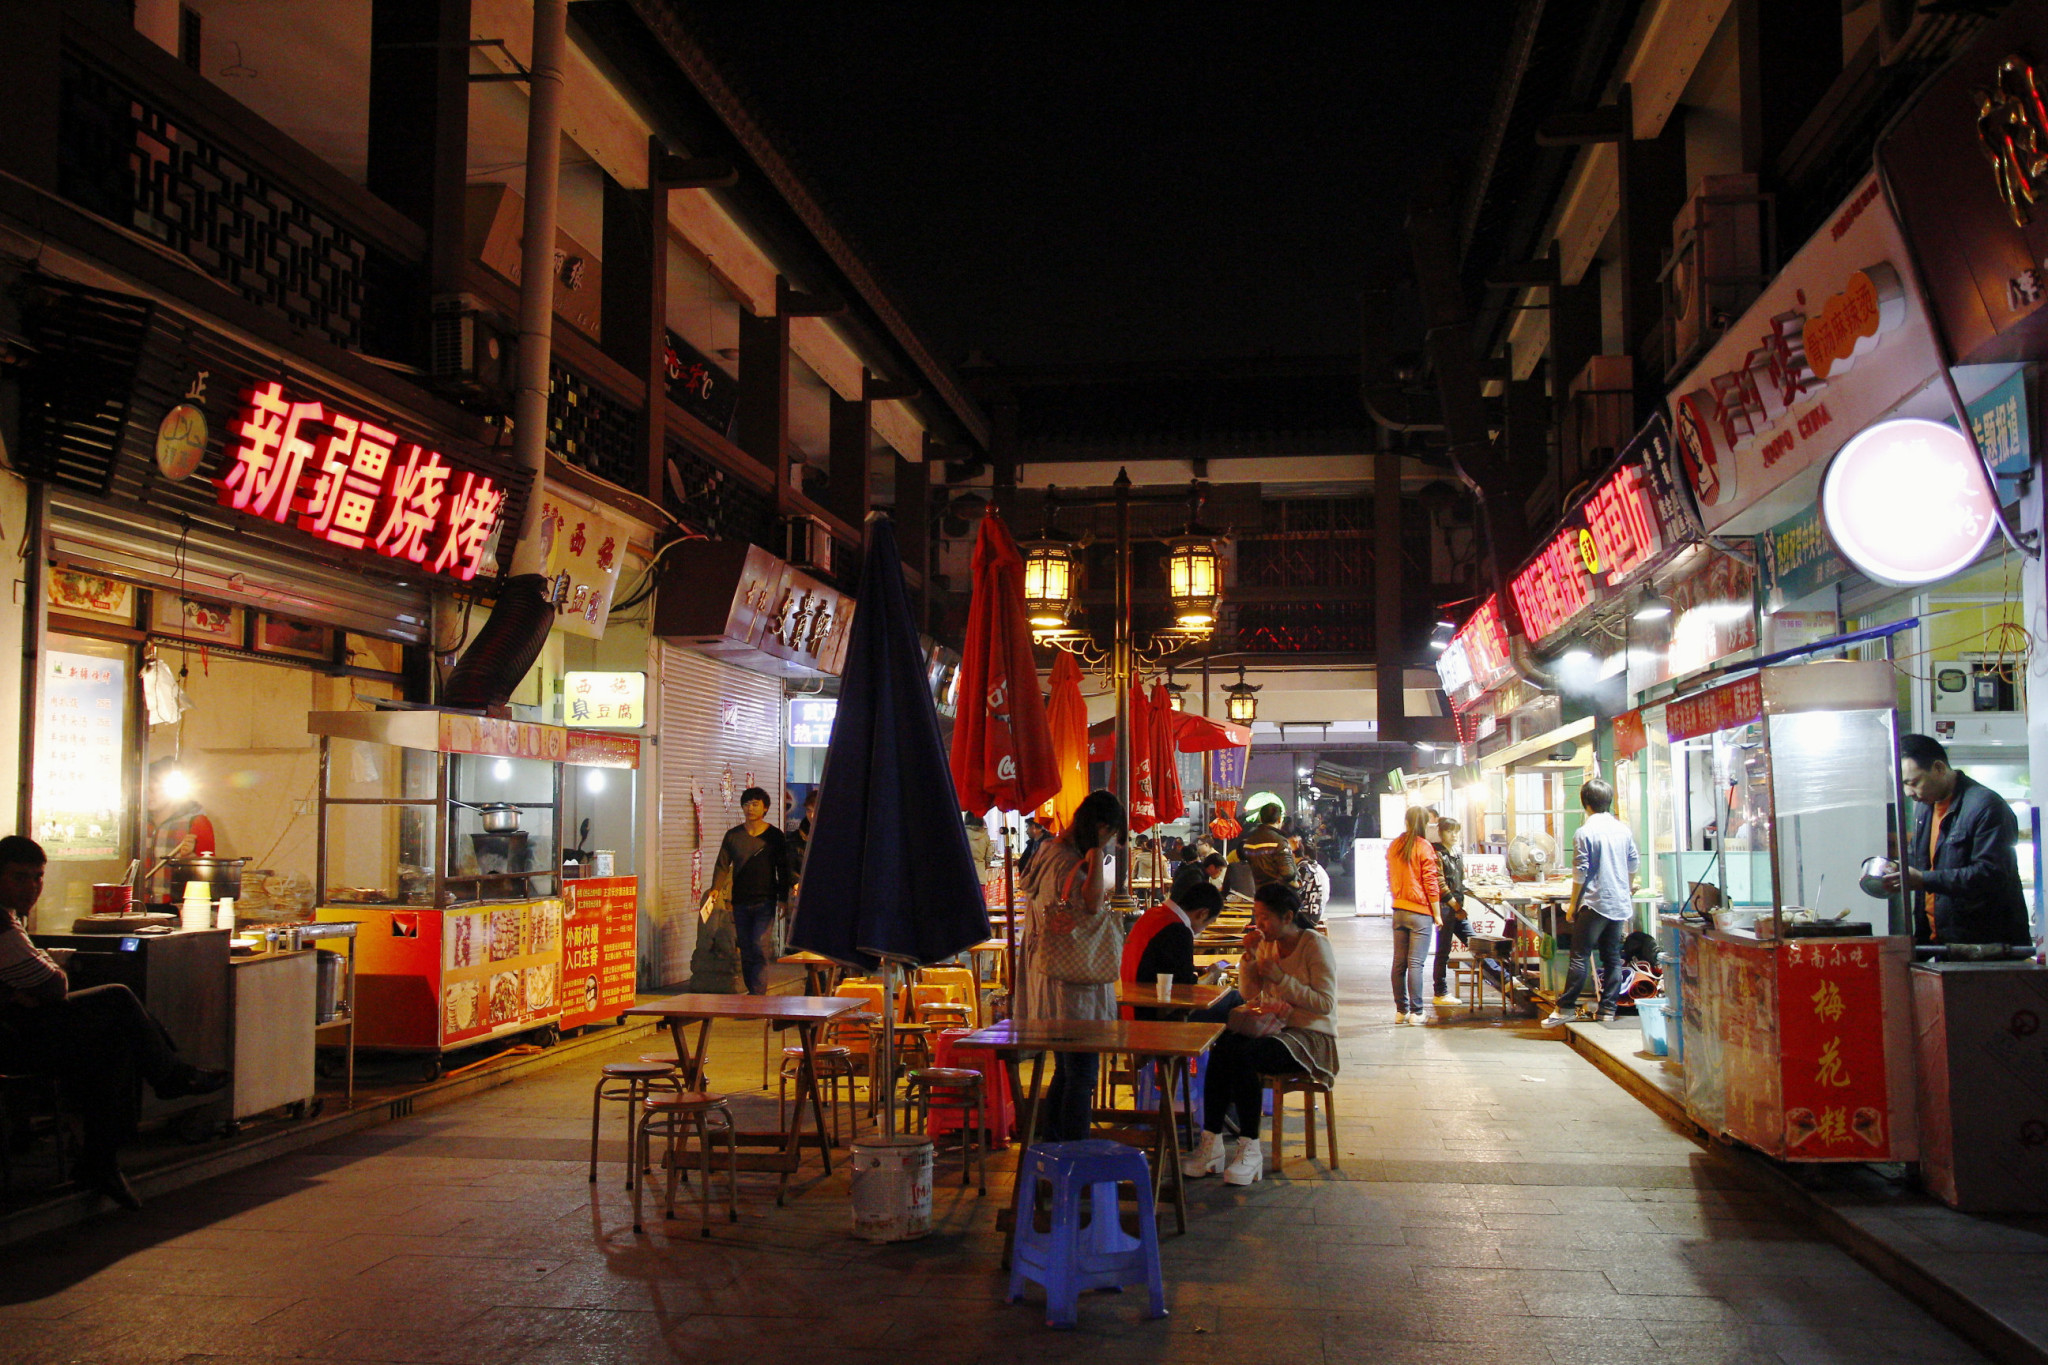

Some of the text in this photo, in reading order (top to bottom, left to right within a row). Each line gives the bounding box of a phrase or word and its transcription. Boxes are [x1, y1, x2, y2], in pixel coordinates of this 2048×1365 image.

[224, 381, 501, 581] 新疆烧烤
[551, 569, 604, 625] 臭豆腐
[575, 677, 630, 696] 西施
[571, 698, 633, 721] 臭豆腐
[565, 923, 599, 948] 外酥内嫩
[565, 945, 599, 970] 入口生香
[1788, 946, 1868, 969] 江南小吃
[1810, 979, 1854, 1148] 梅花糕
